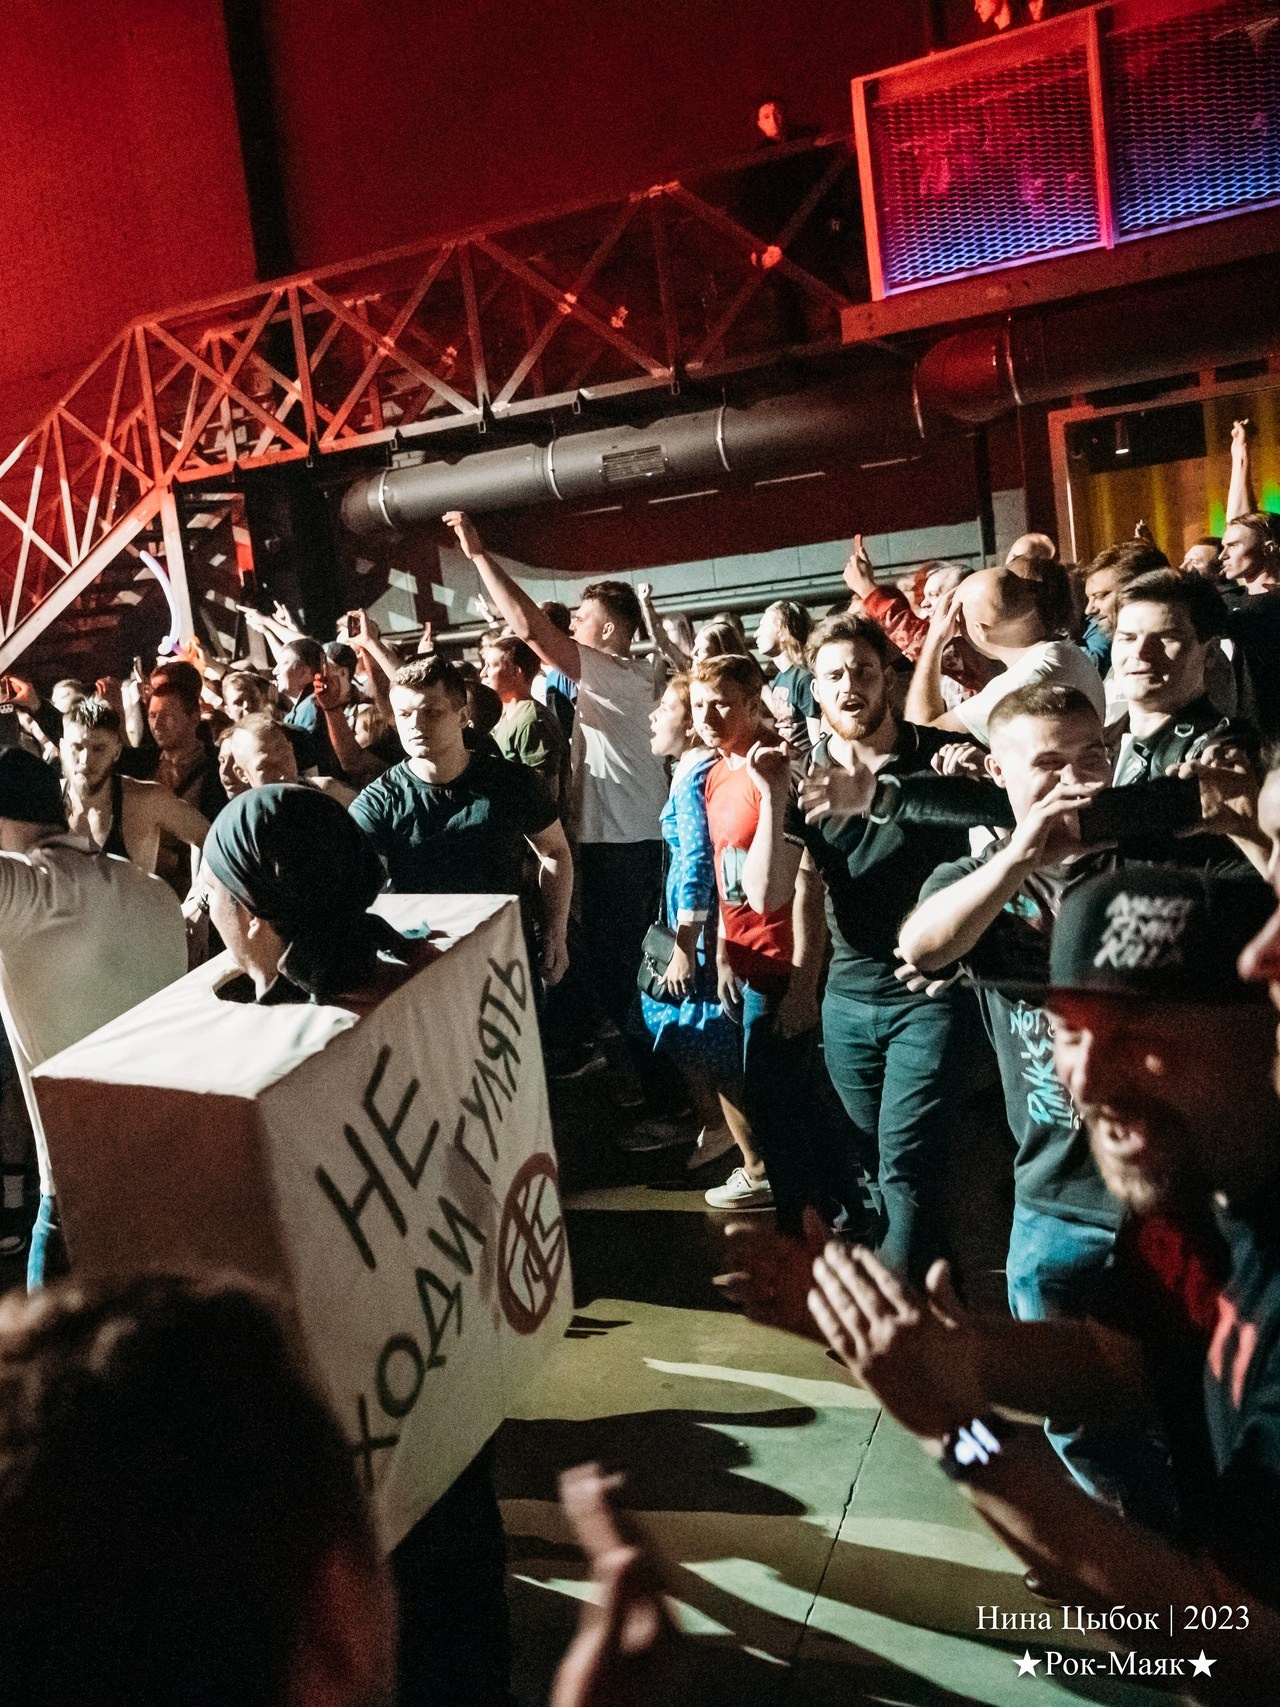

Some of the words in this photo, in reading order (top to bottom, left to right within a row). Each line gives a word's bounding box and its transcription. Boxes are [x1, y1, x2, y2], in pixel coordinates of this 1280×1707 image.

[1010, 1009, 1042, 1035] NOT
[315, 1044, 440, 1270] НЕ
[352, 1196, 487, 1494] ХОДИ
[453, 957, 527, 1186] ГУЛЯТЬ
